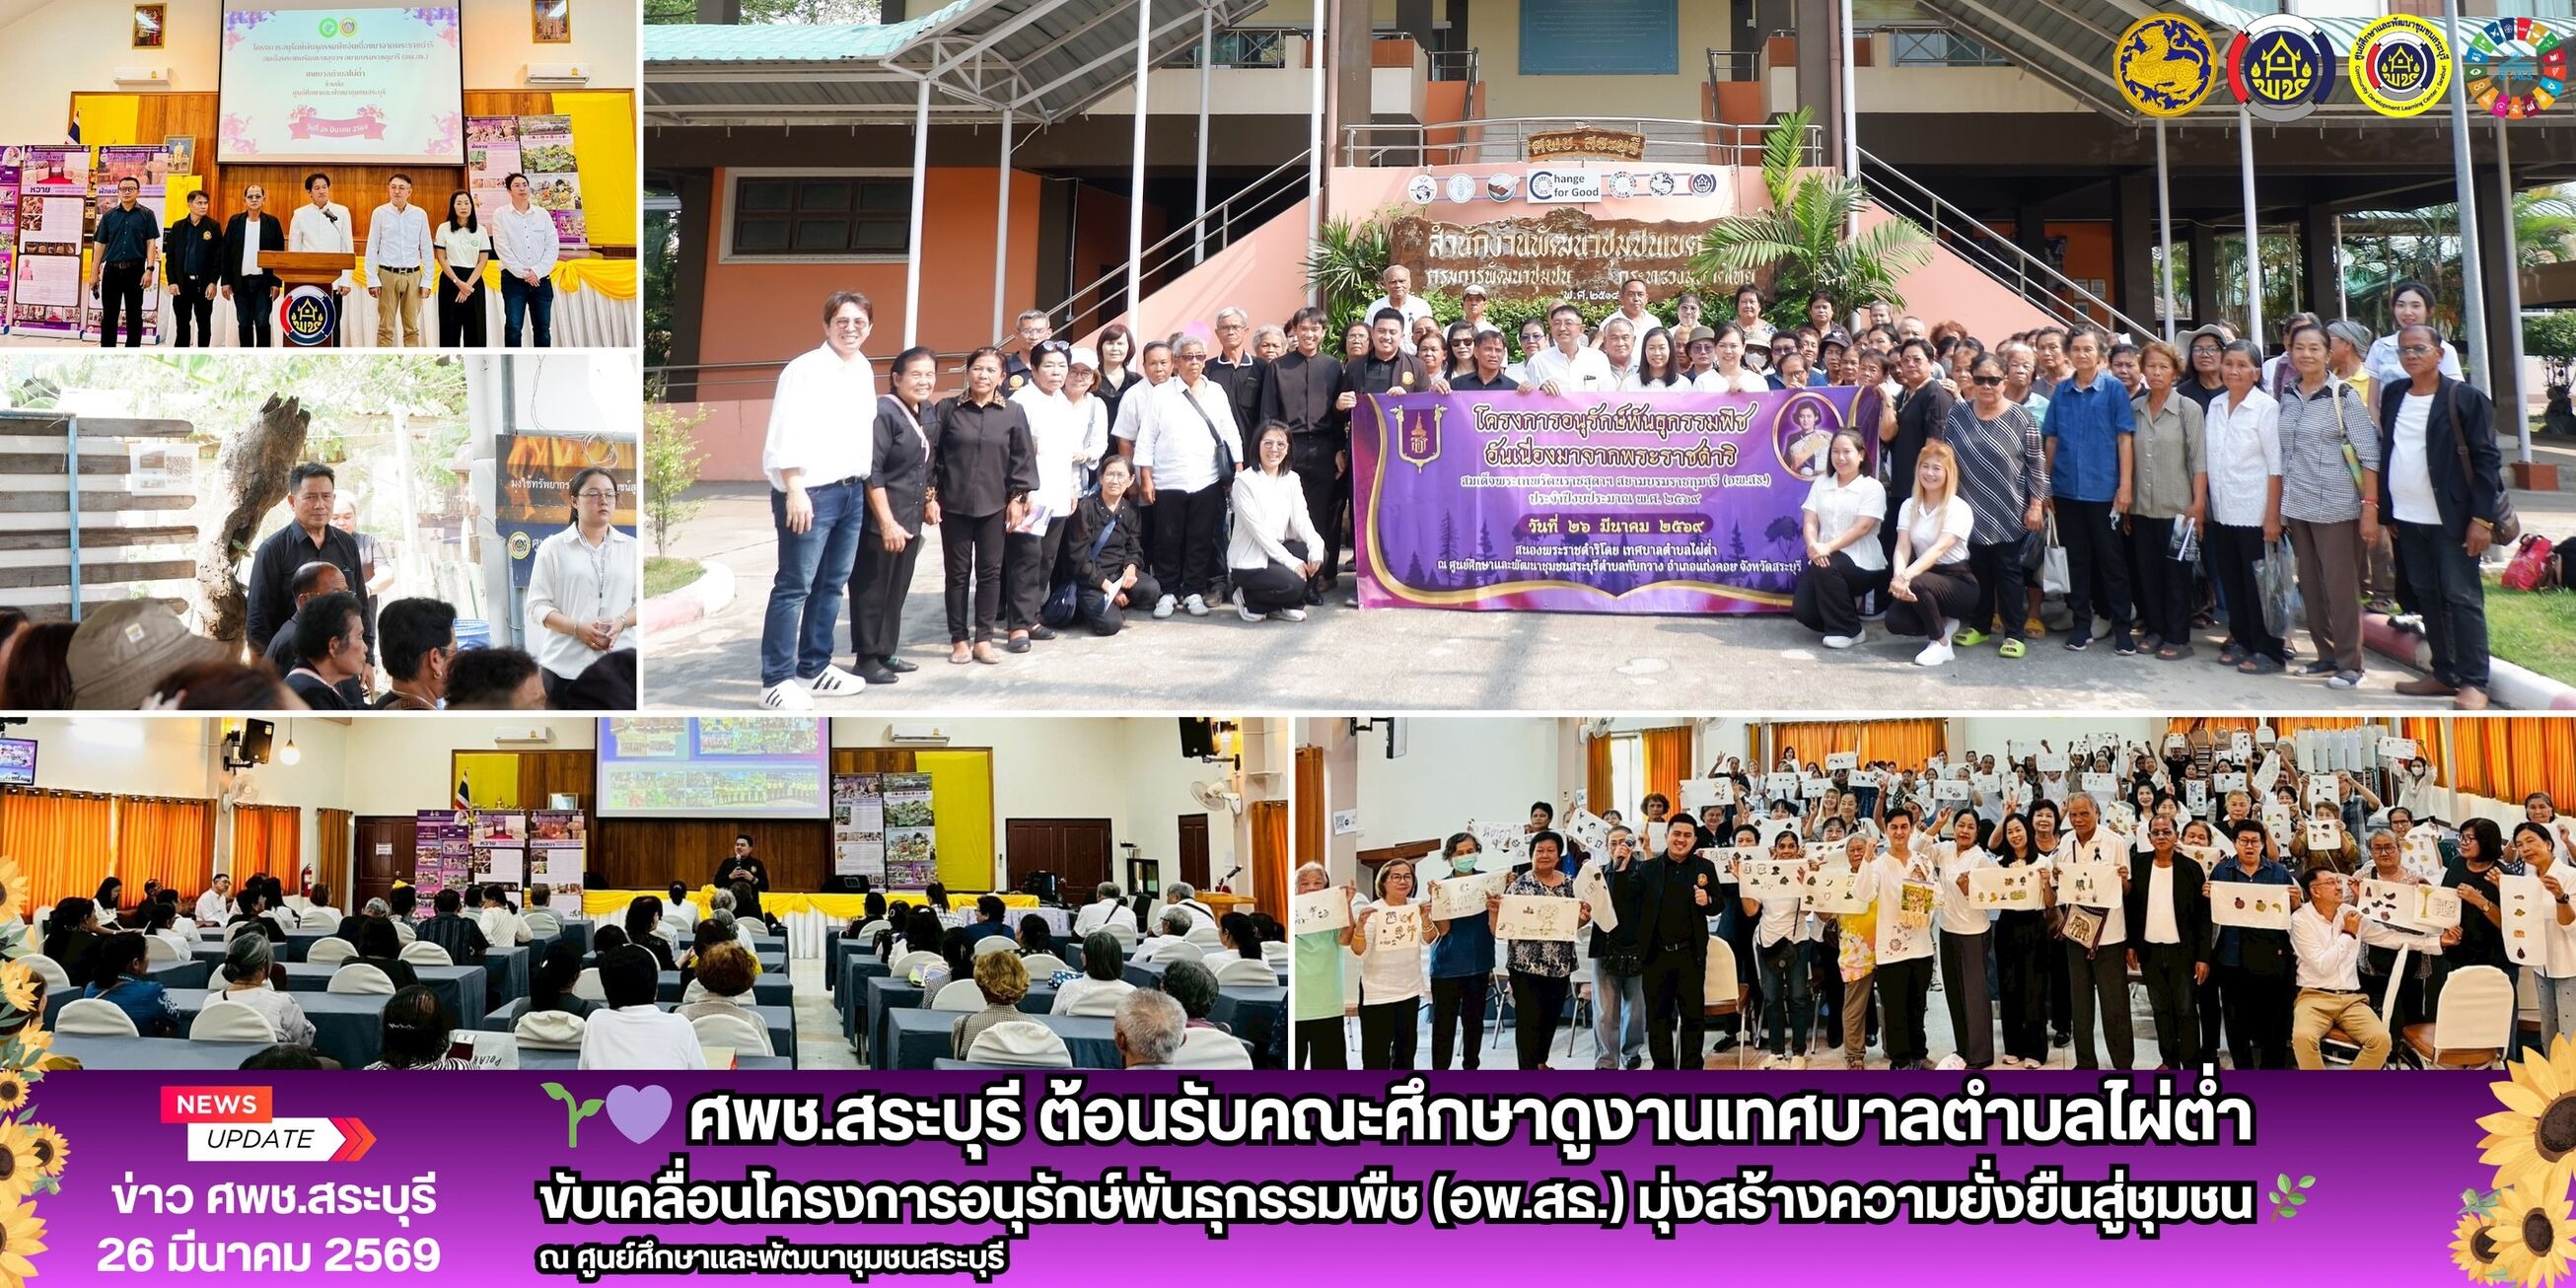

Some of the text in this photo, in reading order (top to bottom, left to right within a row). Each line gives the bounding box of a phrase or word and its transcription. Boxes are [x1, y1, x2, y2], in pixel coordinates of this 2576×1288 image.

[1554, 185, 1600, 198] for Good
[1472, 403, 1759, 439] โครงการอนุรักษ์พันธุกรรมพืช
[1484, 437, 1738, 467] อันเนื่องมาจากพระราชดำริ
[1528, 512, 1706, 535] วันที่ ๒๖ มีนาคม ๒๕๖๙
[1622, 538, 1719, 556] เทศบาลตำบลไผ่ต่ำ
[1437, 561, 1448, 571] ณ
[1667, 559, 1738, 573] อำเภอแก่งคอย
[1740, 559, 1803, 576] จังหวัดสระบุรี
